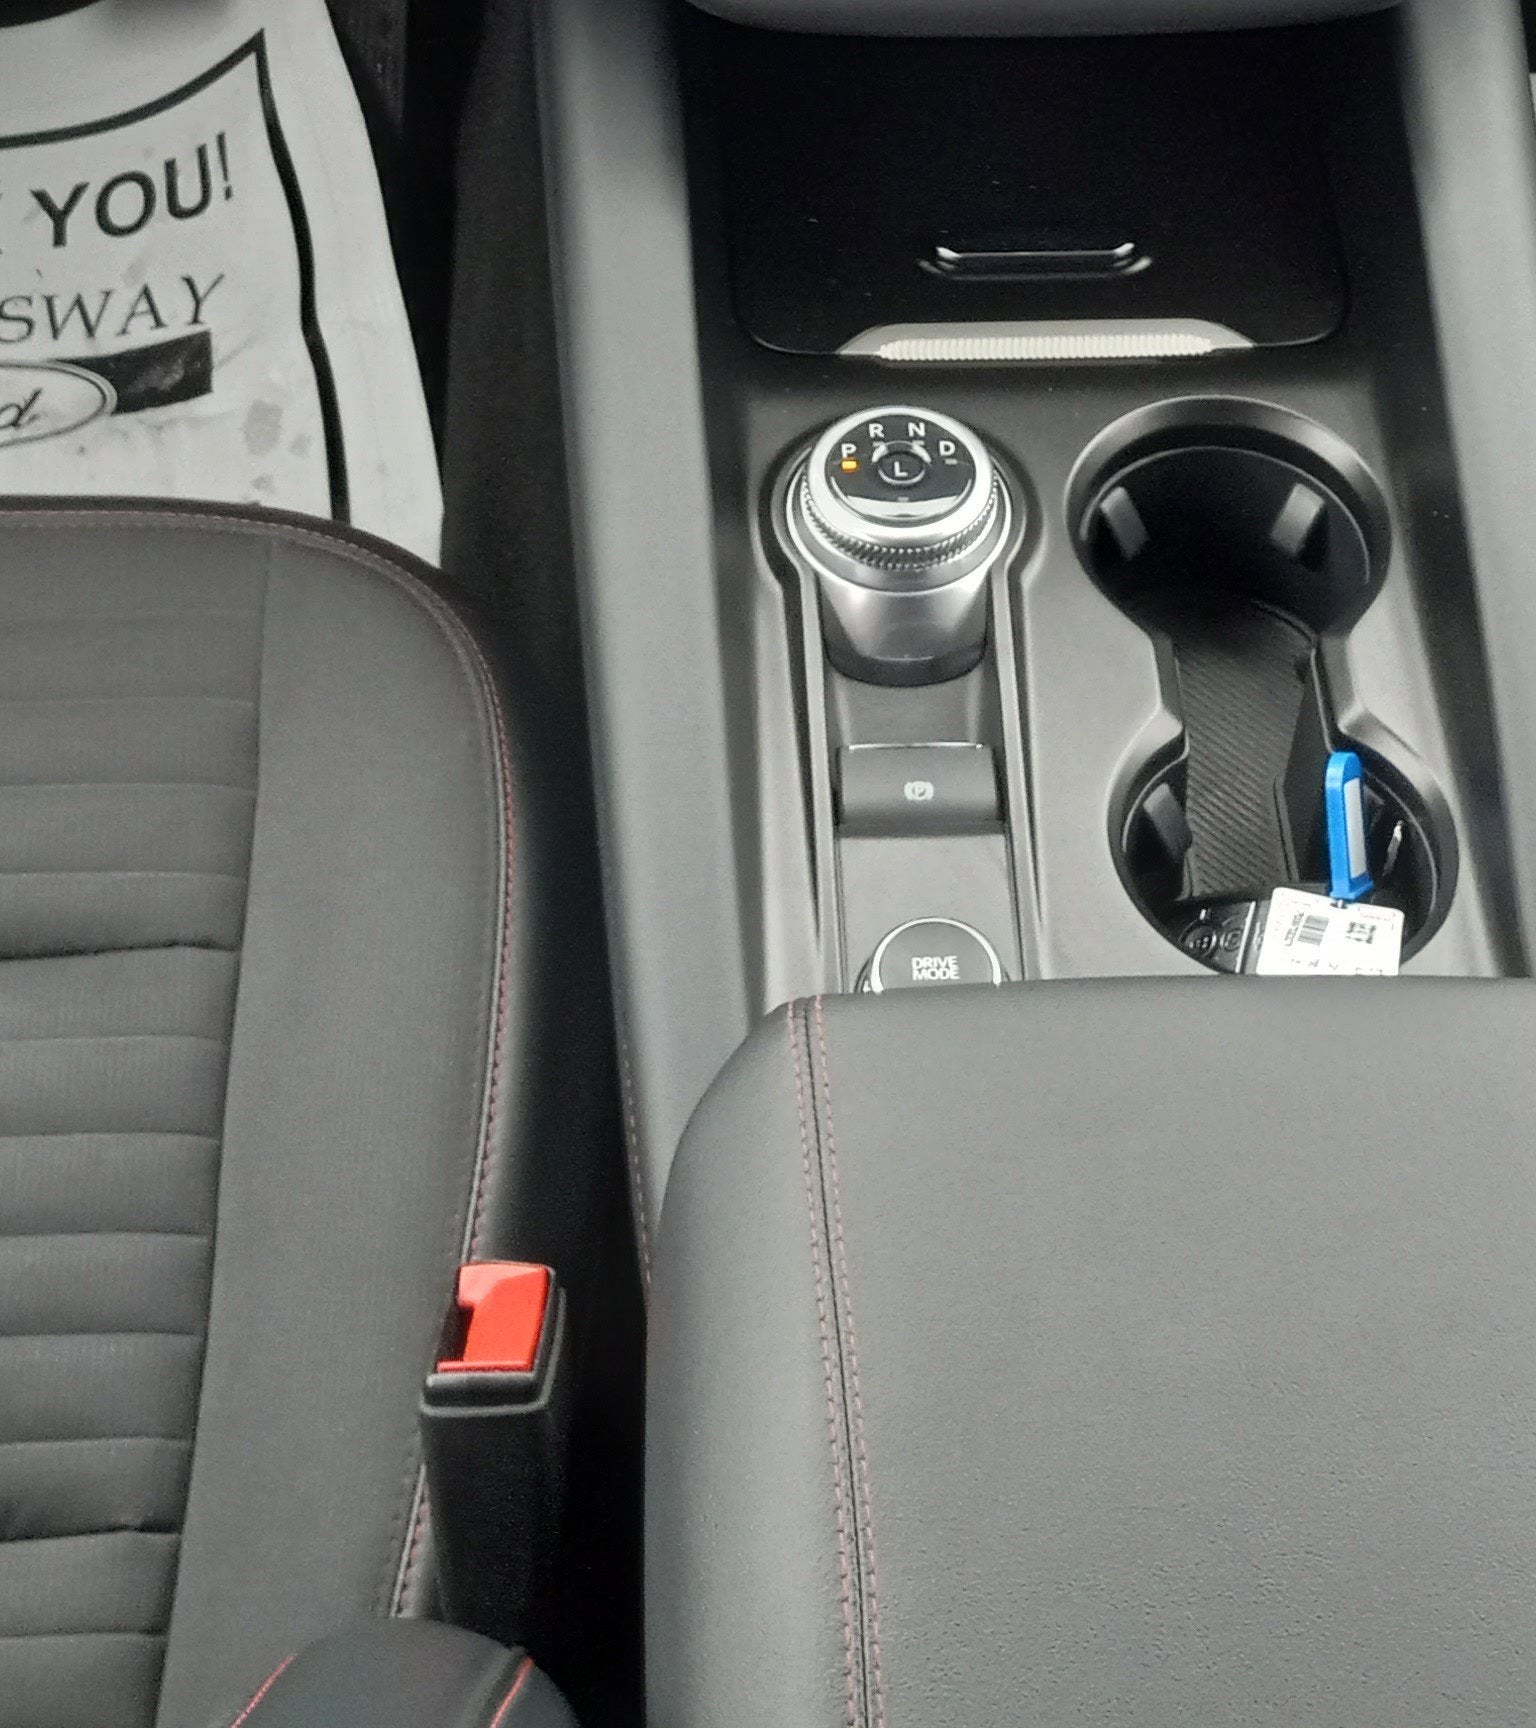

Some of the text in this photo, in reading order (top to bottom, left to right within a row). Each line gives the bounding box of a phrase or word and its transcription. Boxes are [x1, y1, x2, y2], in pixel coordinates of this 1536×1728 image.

[30, 132, 234, 250] YOU!
[869, 423, 885, 438] R
[908, 422, 926, 437] N
[841, 443, 857, 459] P
[939, 440, 956, 456] D
[894, 461, 908, 477] L
[911, 955, 959, 970] DRIVE
[912, 968, 960, 981] MODE
